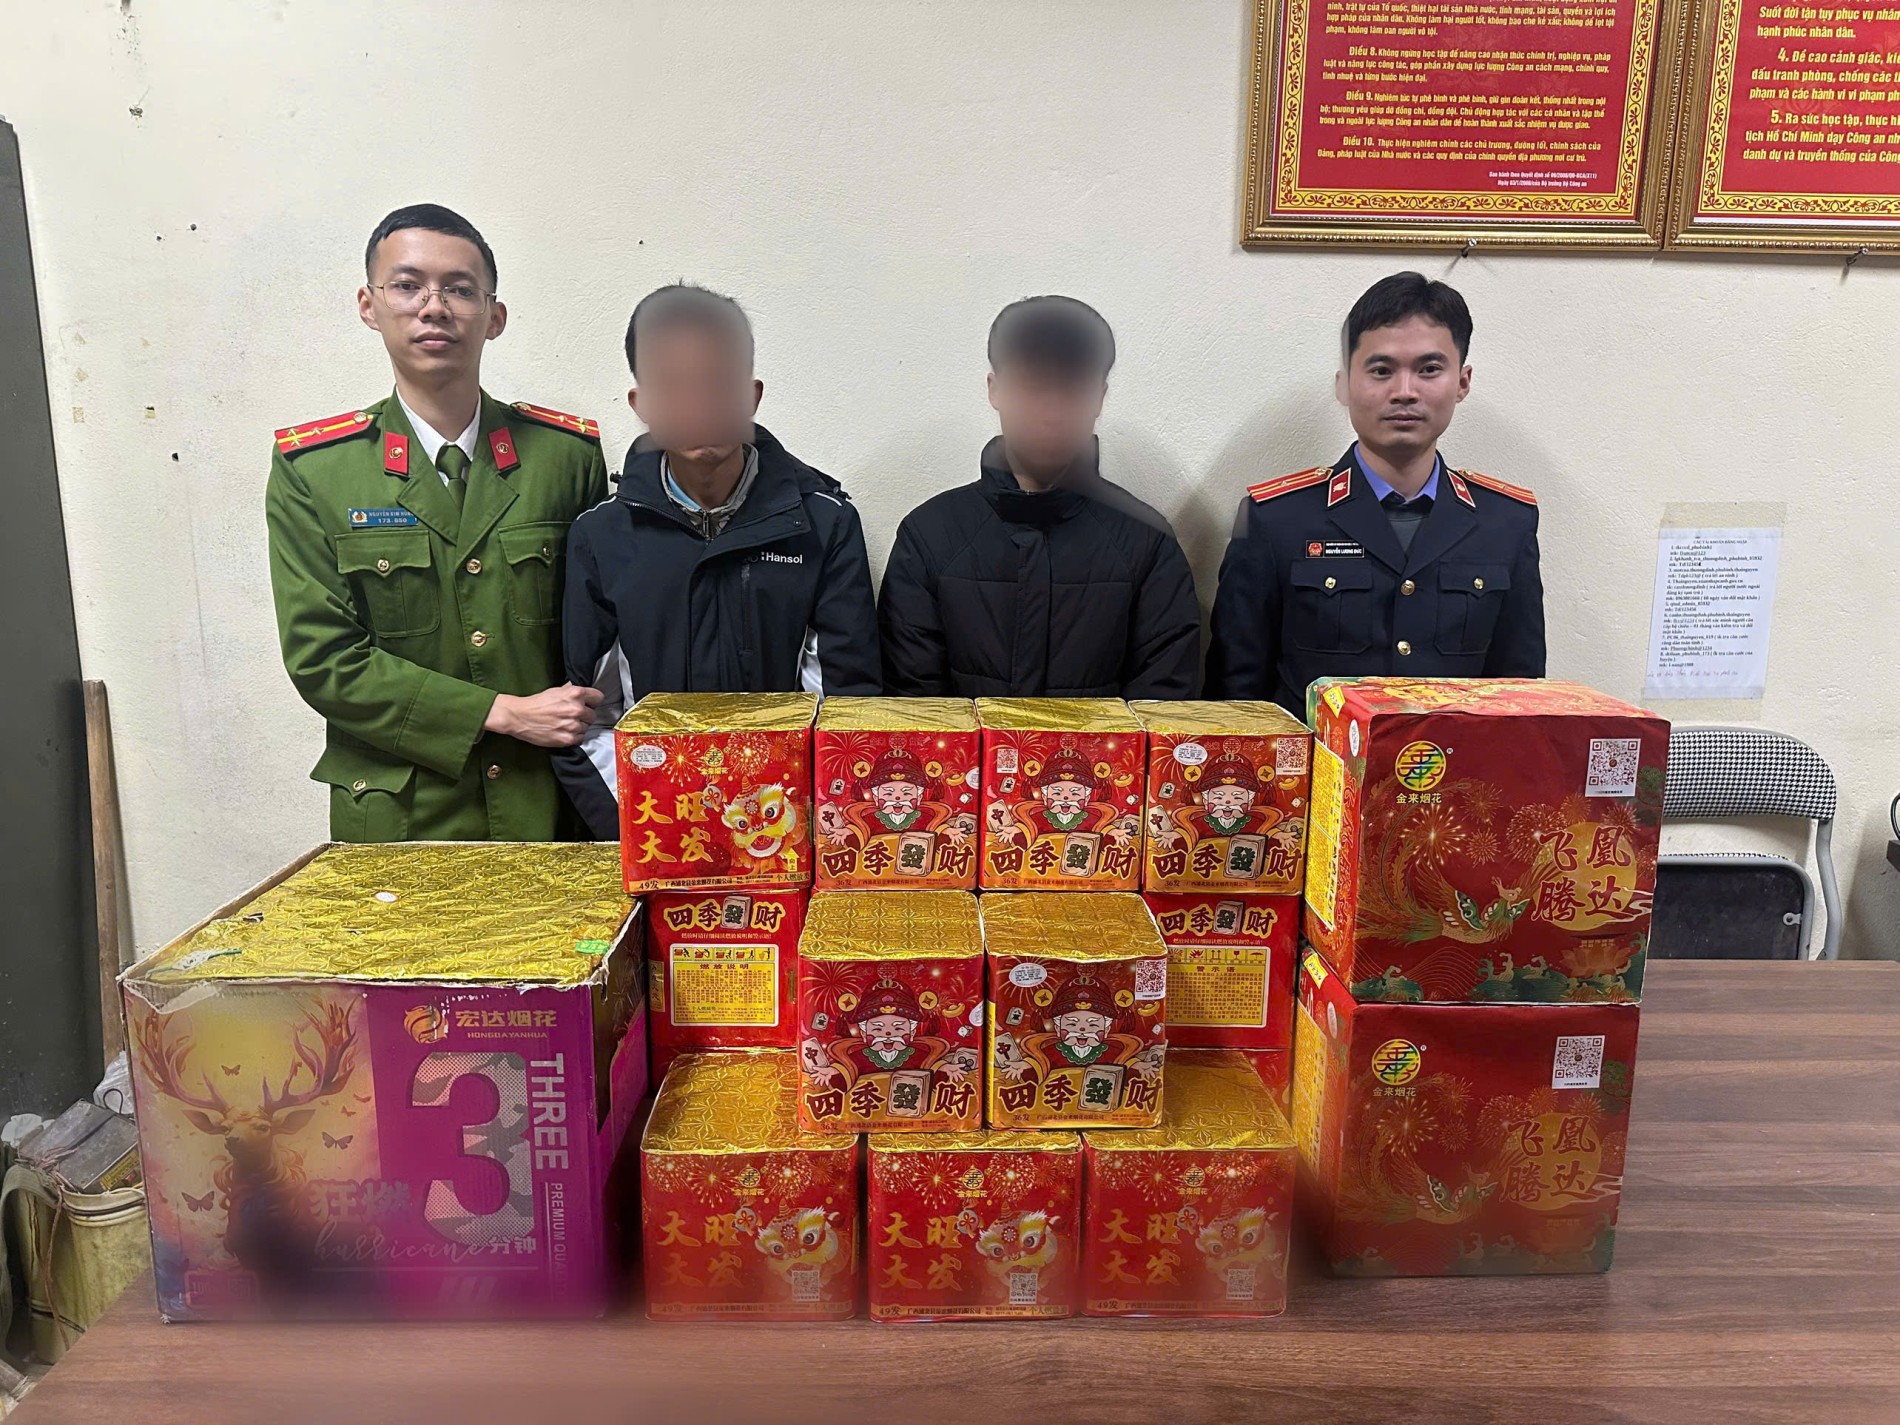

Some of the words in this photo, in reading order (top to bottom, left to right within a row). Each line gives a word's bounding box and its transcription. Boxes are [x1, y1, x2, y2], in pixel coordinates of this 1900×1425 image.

[1759, 5, 1781, 18] Suốt
[1784, 7, 1799, 19] đời
[1801, 7, 1816, 21] tận
[1819, 8, 1834, 22] tụy
[1835, 8, 1859, 22] phục
[1862, 10, 1874, 22] vụ
[1757, 25, 1780, 38] hạnh
[1783, 25, 1807, 38] phúc
[1809, 26, 1833, 38] nhân
[1836, 27, 1856, 38] dân.
[1349, 45, 1368, 56] Điều
[1369, 46, 1378, 56] 8.
[1778, 47, 1789, 62] 4.
[1808, 53, 1827, 63] cao
[1830, 50, 1855, 63] cảnh
[1858, 51, 1884, 64] giác,
[1751, 67, 1770, 80] đấu
[1773, 70, 1800, 80] tranh
[1802, 70, 1836, 82] phòng,
[1839, 69, 1870, 83] chống
[1872, 70, 1892, 82] các
[1750, 87, 1775, 100] phạm
[1779, 88, 1789, 98] và
[1792, 88, 1809, 99] các
[1812, 88, 1835, 100] hành
[1838, 89, 1845, 100] vi
[1848, 89, 1857, 100] vi
[1859, 90, 1885, 103] phạm
[1771, 110, 1782, 124] 5.
[1785, 113, 1799, 124] Ra
[1801, 113, 1819, 124] sức
[1822, 114, 1841, 126] học
[1843, 114, 1863, 127] tập,
[1865, 115, 1888, 128] thực
[1343, 135, 1361, 146] Điều
[1363, 137, 1375, 146] 10.
[1745, 130, 1764, 143] tịch
[1766, 129, 1780, 142] Hồ
[1781, 130, 1798, 142] Chí
[1800, 131, 1824, 142] Minh
[1827, 132, 1844, 145] dạy
[1846, 132, 1870, 145] Công
[1873, 134, 1885, 143] an
[1743, 148, 1767, 160] danh
[1769, 149, 1782, 162] dự
[1784, 149, 1795, 160] và
[1797, 148, 1828, 162] truyền
[1830, 148, 1856, 163] thống
[1858, 149, 1877, 161] của
[766, 552, 803, 564] Hansol
[1395, 792, 1442, 804] 金来烟花
[637, 827, 713, 863] 大发
[455, 1010, 557, 1027] 宏达烟花
[1373, 1086, 1417, 1097] 金来烟花
[530, 1052, 569, 1170] THREE
[411, 1052, 535, 1248] 3
[550, 1182, 566, 1240] PREMIUM
[489, 1237, 537, 1255] 分钟
